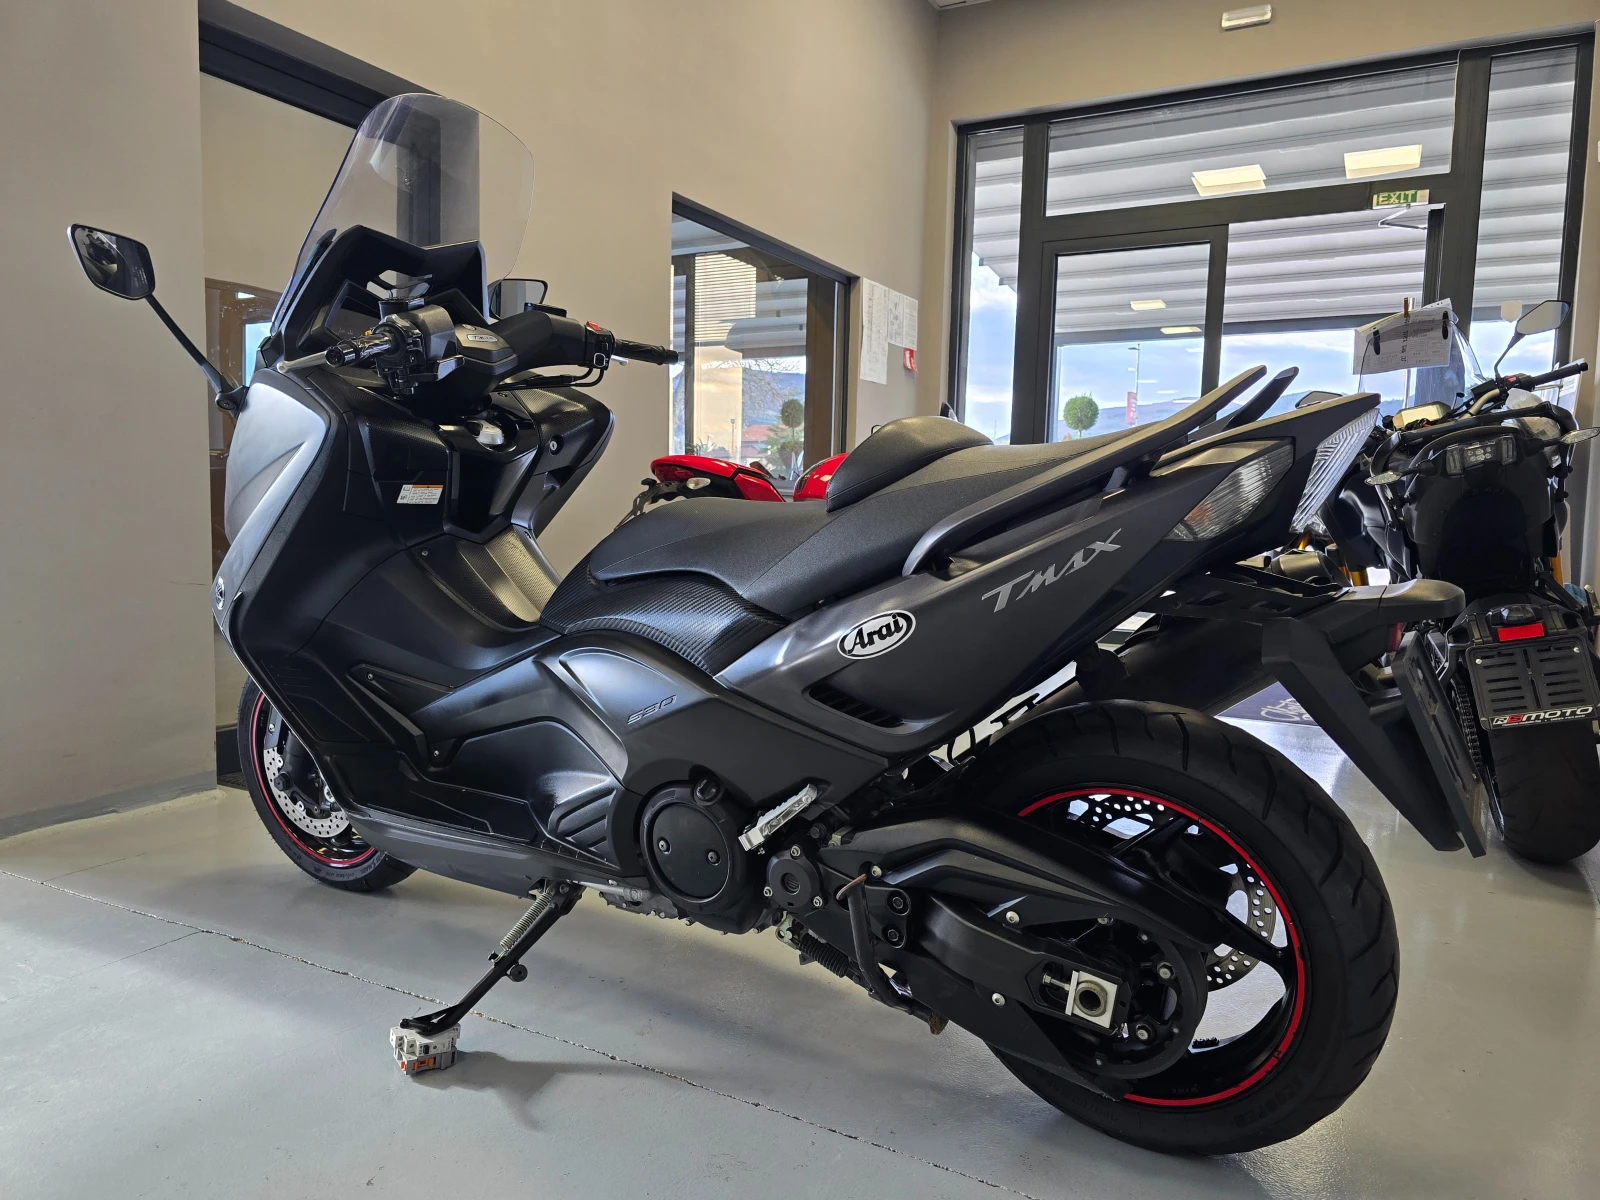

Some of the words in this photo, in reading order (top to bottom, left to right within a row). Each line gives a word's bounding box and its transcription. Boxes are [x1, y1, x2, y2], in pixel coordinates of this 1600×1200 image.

[1379, 189, 1415, 205] EXIT
[846, 612, 905, 655] Arai
[627, 694, 677, 725] 530
